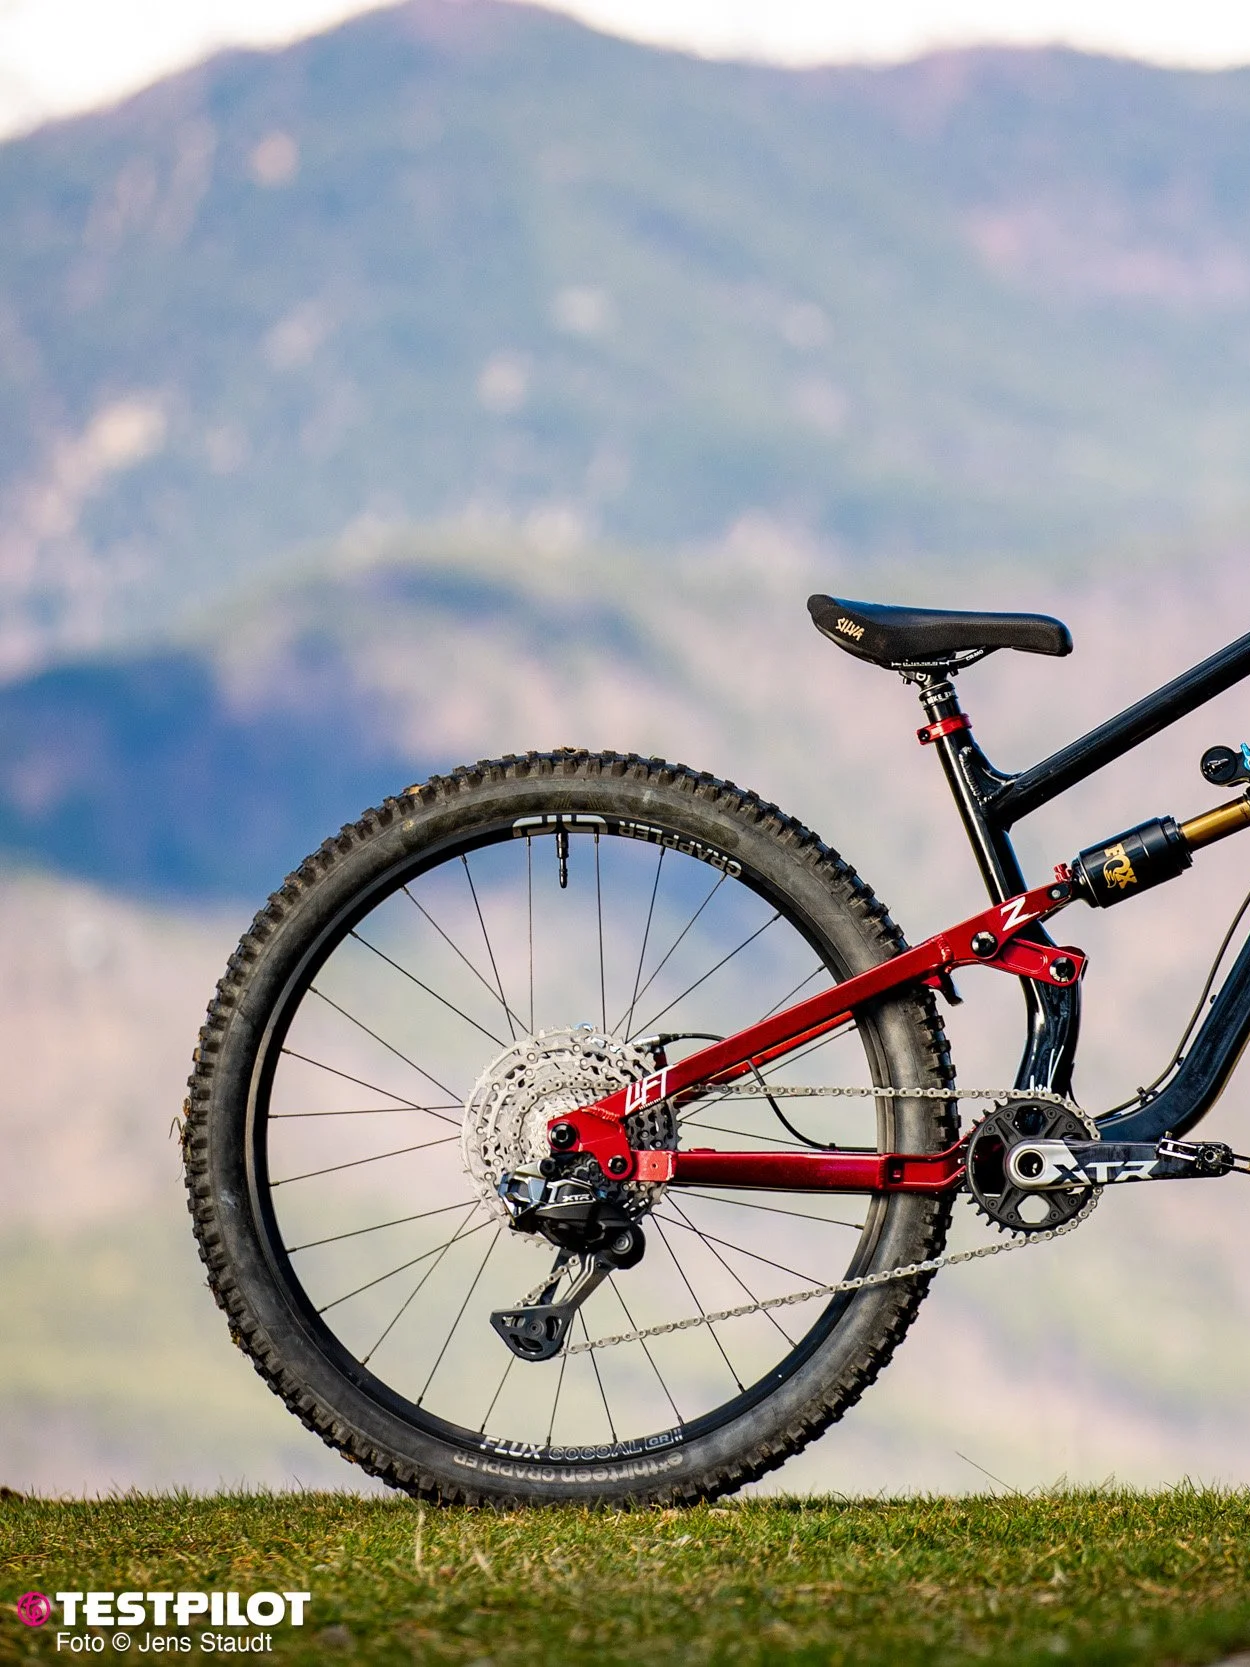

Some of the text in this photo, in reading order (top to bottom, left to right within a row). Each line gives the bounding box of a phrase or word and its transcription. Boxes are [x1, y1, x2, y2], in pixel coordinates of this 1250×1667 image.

[618, 820, 742, 878] GRAPPLER
[1046, 1159, 1160, 1187] XTR
[561, 1193, 591, 1203] XTR
[480, 1436, 544, 1460] FLUX
[453, 1450, 553, 1482] GRAPPLER
